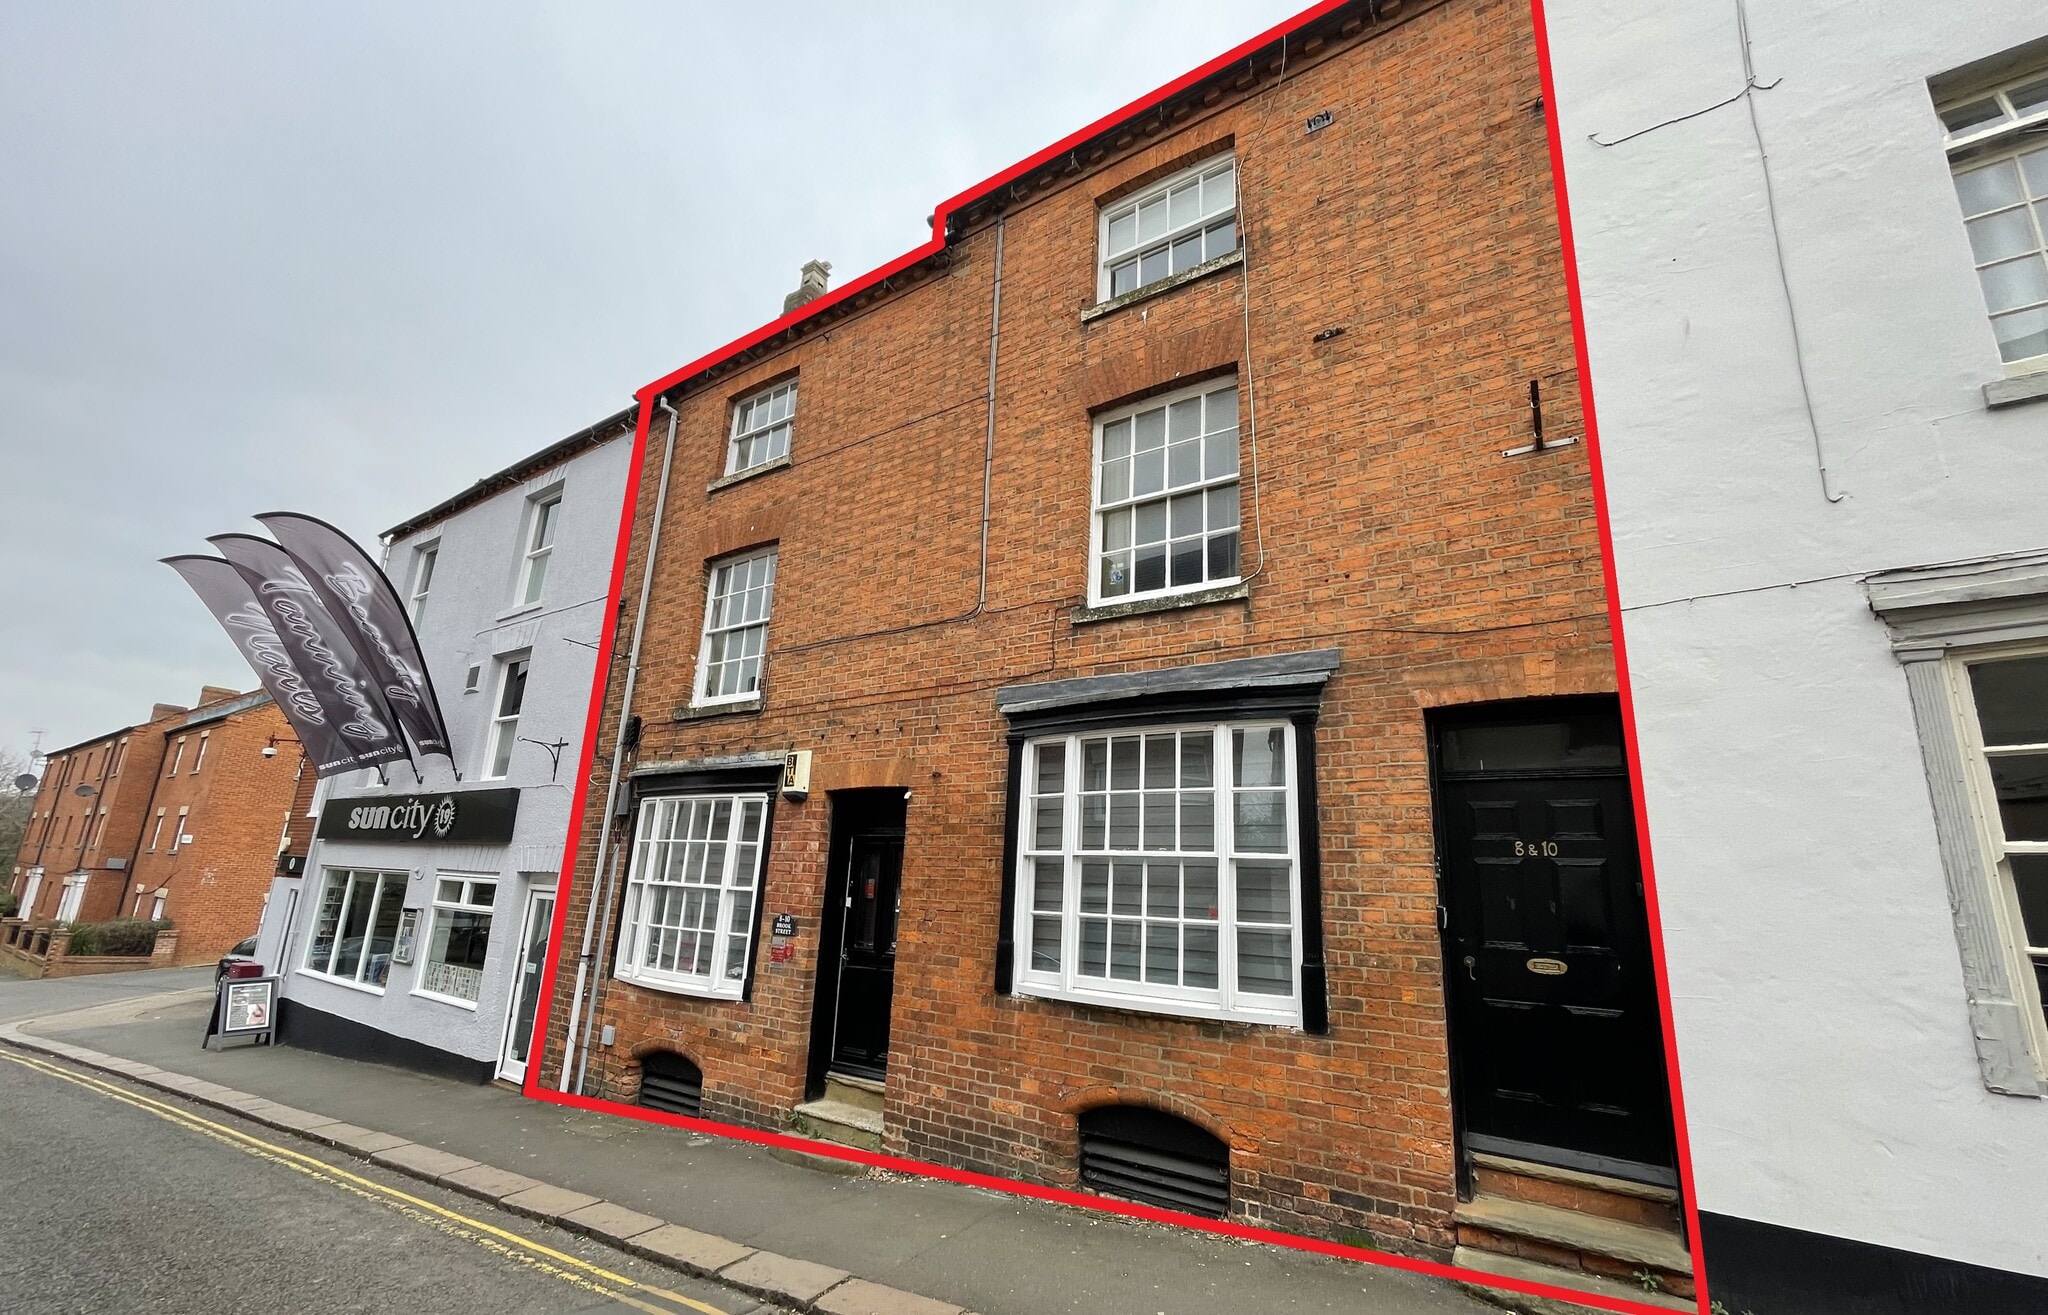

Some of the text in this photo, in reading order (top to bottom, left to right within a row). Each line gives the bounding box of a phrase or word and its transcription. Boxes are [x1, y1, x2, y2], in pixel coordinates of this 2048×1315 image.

[262, 567, 388, 740] Tanning
[325, 562, 422, 708] Beauty
[226, 602, 324, 724] Nails
[318, 755, 357, 771] suncit
[358, 744, 397, 760] suncity
[348, 798, 434, 839] suncity
[1514, 840, 1558, 857] 8 & 10
